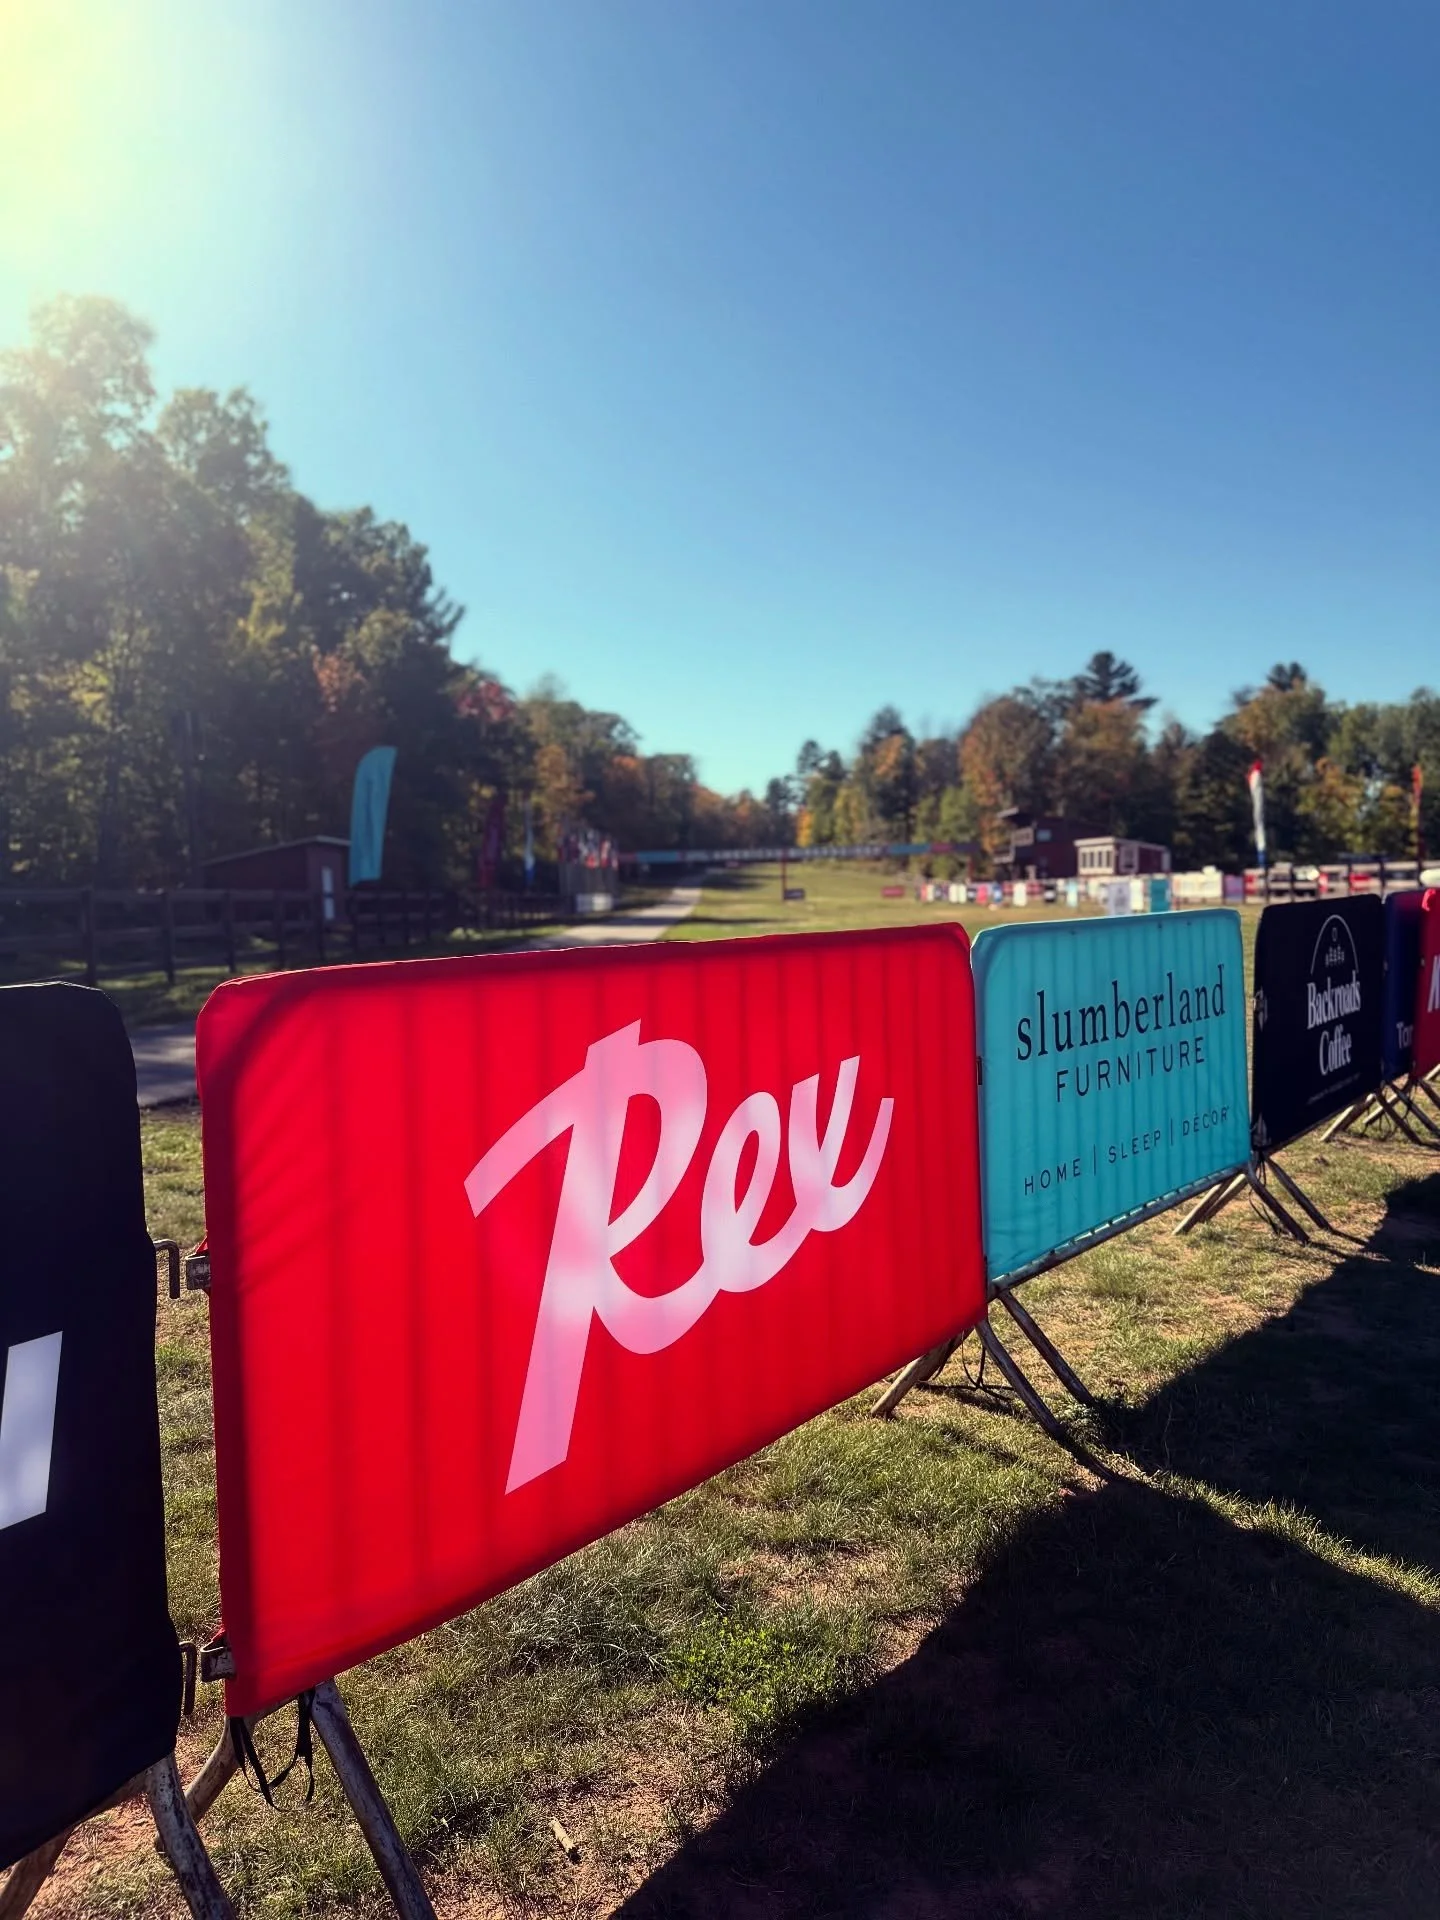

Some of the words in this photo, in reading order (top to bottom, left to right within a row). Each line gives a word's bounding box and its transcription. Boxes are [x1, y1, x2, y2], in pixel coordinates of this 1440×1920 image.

[1017, 964, 1226, 1061] slumberland
[1307, 970, 1361, 1029] Backroads
[1056, 1037, 1205, 1102] FURNITURE
[1320, 1024, 1352, 1075] Coffee
[1024, 1158, 1081, 1196] HOME
[1108, 1130, 1161, 1164] SLEEP
[464, 1018, 895, 1496] Rex
